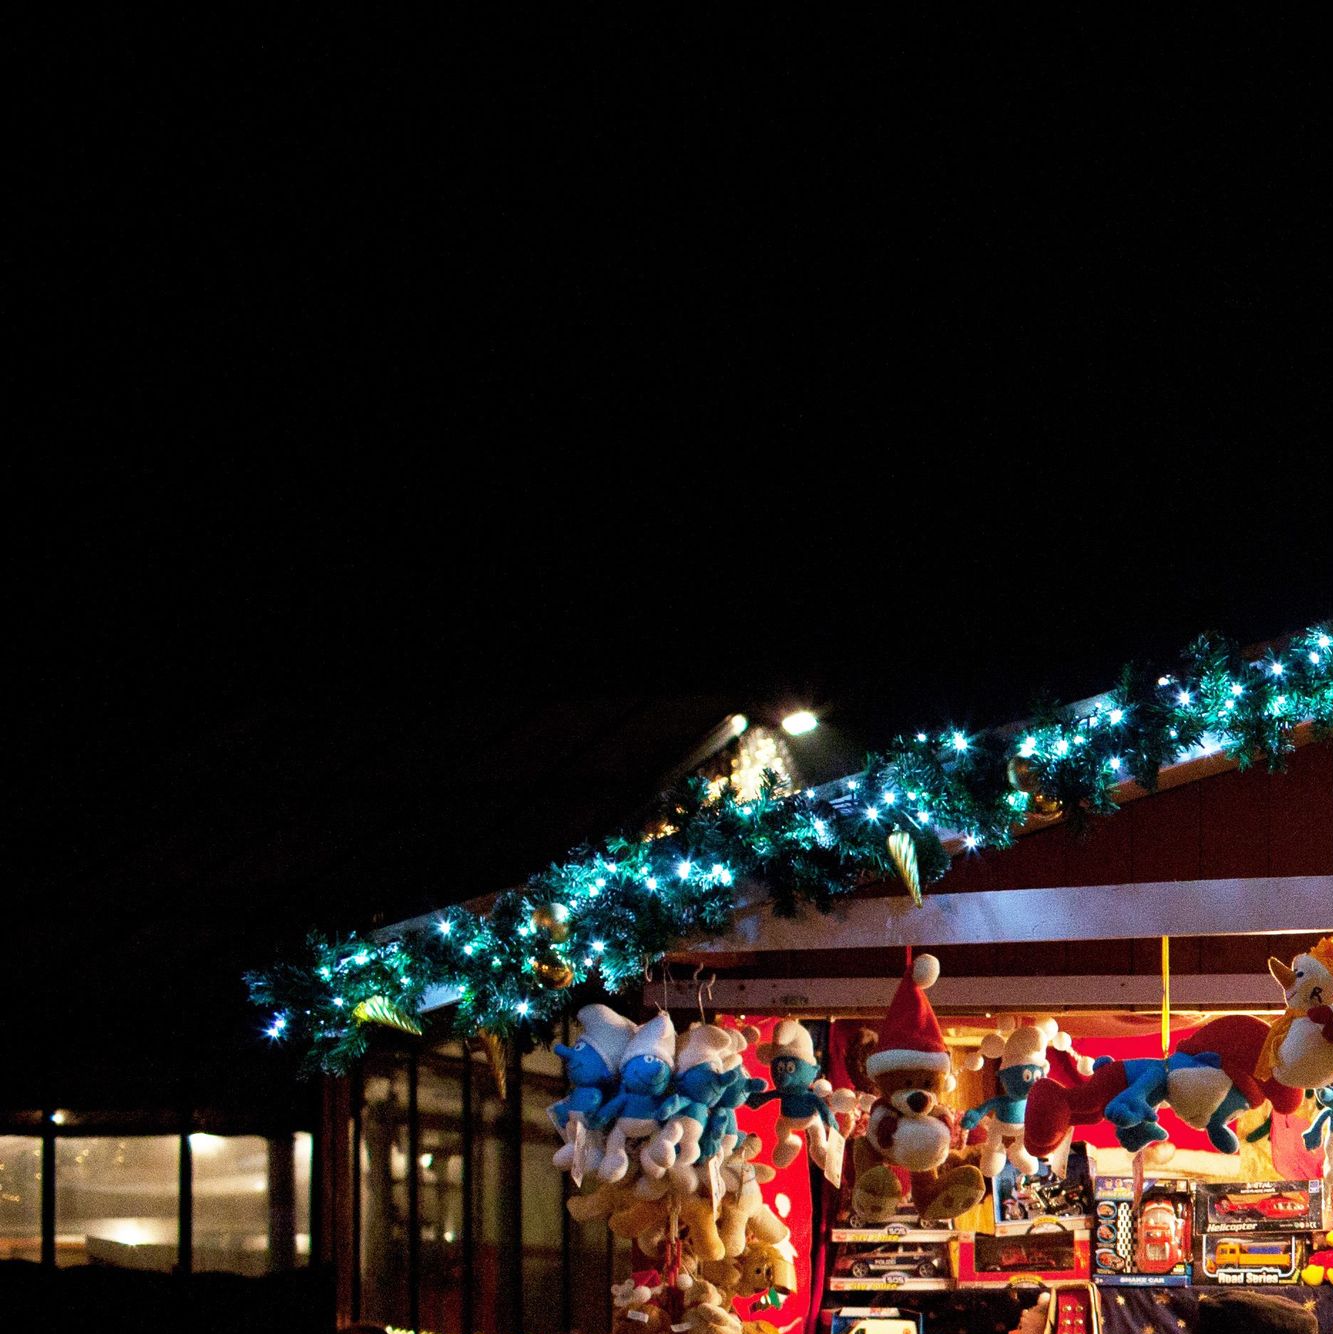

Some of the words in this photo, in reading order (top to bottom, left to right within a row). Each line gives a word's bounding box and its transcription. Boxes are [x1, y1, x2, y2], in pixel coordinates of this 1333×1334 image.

[1206, 1222, 1258, 1233] Helicopter
[1148, 1276, 1165, 1284] CAR
[1217, 1271, 1246, 1285] Road
[1246, 1271, 1279, 1284] Series
